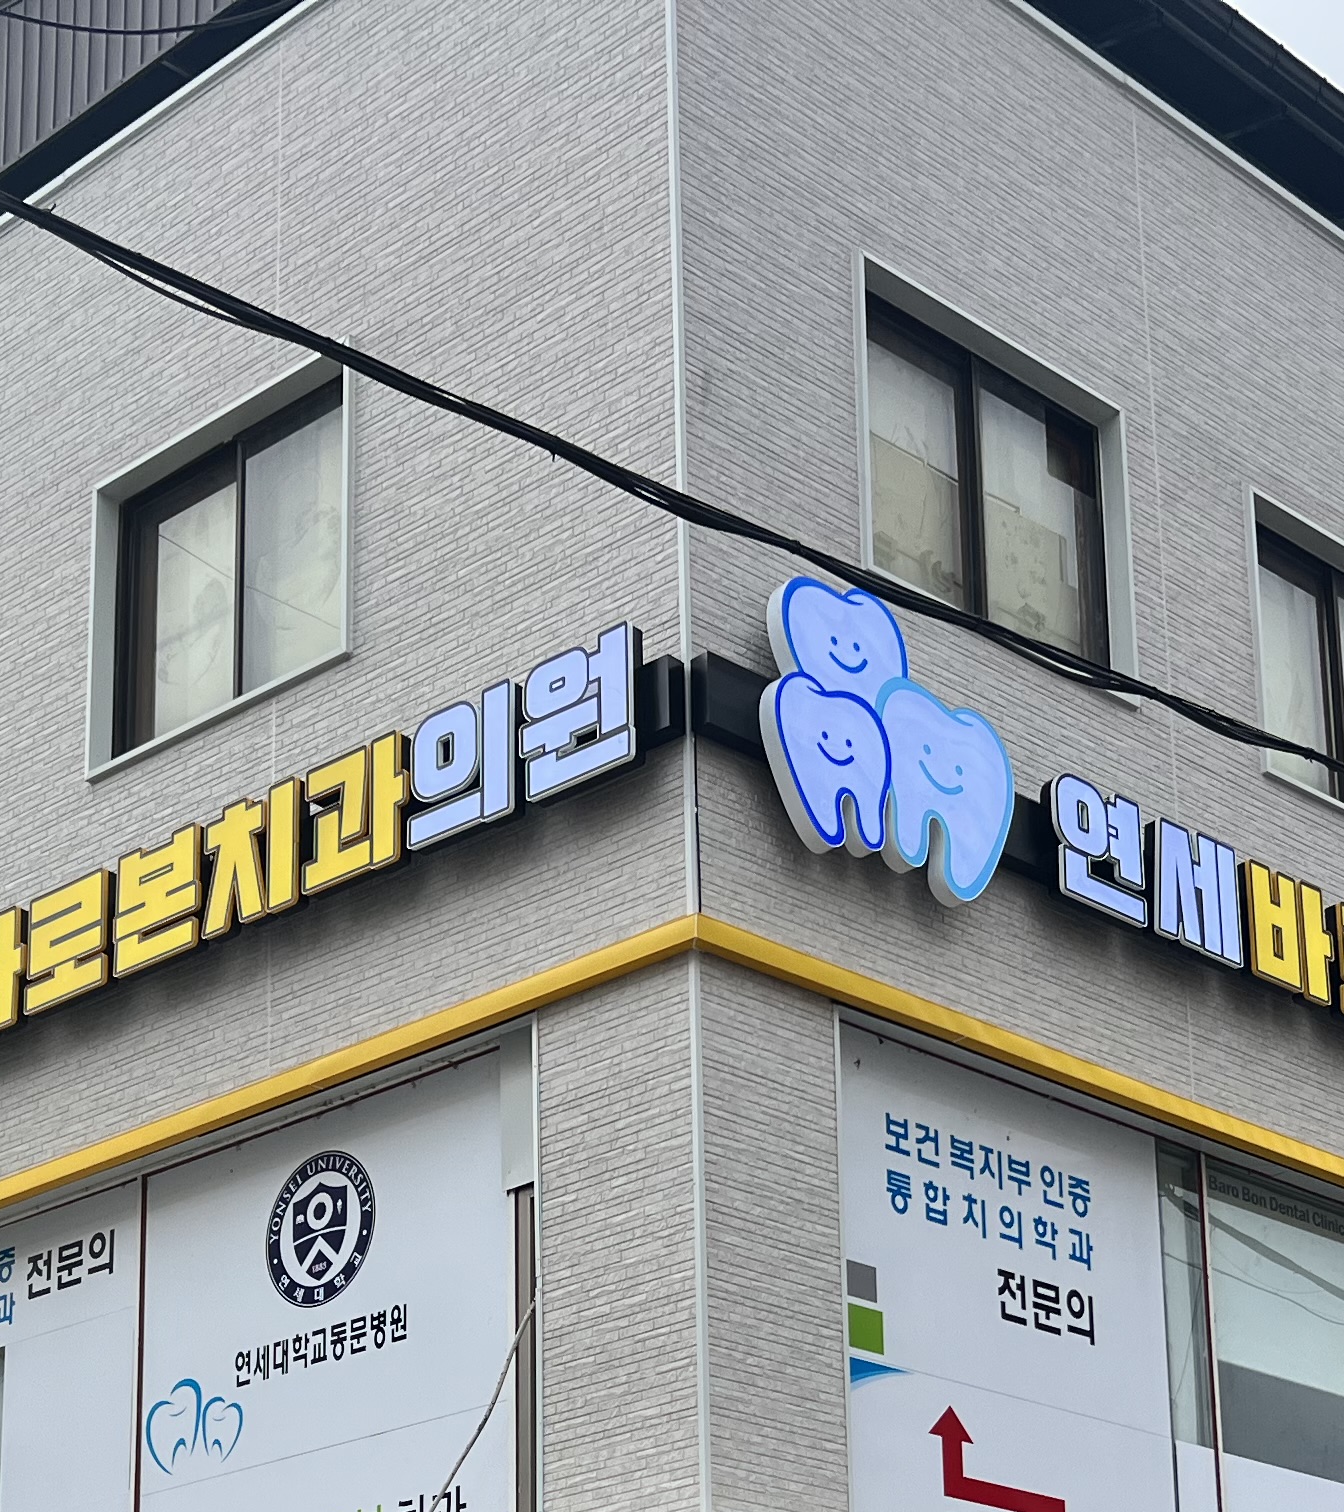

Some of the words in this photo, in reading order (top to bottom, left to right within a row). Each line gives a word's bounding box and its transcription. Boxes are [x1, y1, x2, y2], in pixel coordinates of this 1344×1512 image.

[270, 1174, 303, 1244] YONSEI
[306, 1156, 371, 1212] UNIVERSITY
[885, 1169, 1094, 1272] 통합치의학과
[1208, 1175, 1239, 1198] Baro
[1242, 1187, 1267, 1208] Bon
[1269, 1197, 1310, 1224] Dental
[27, 1229, 116, 1302] 전문의
[235, 1304, 408, 1388] 연세대학교동문병원
[996, 1267, 1097, 1346] 전문의
